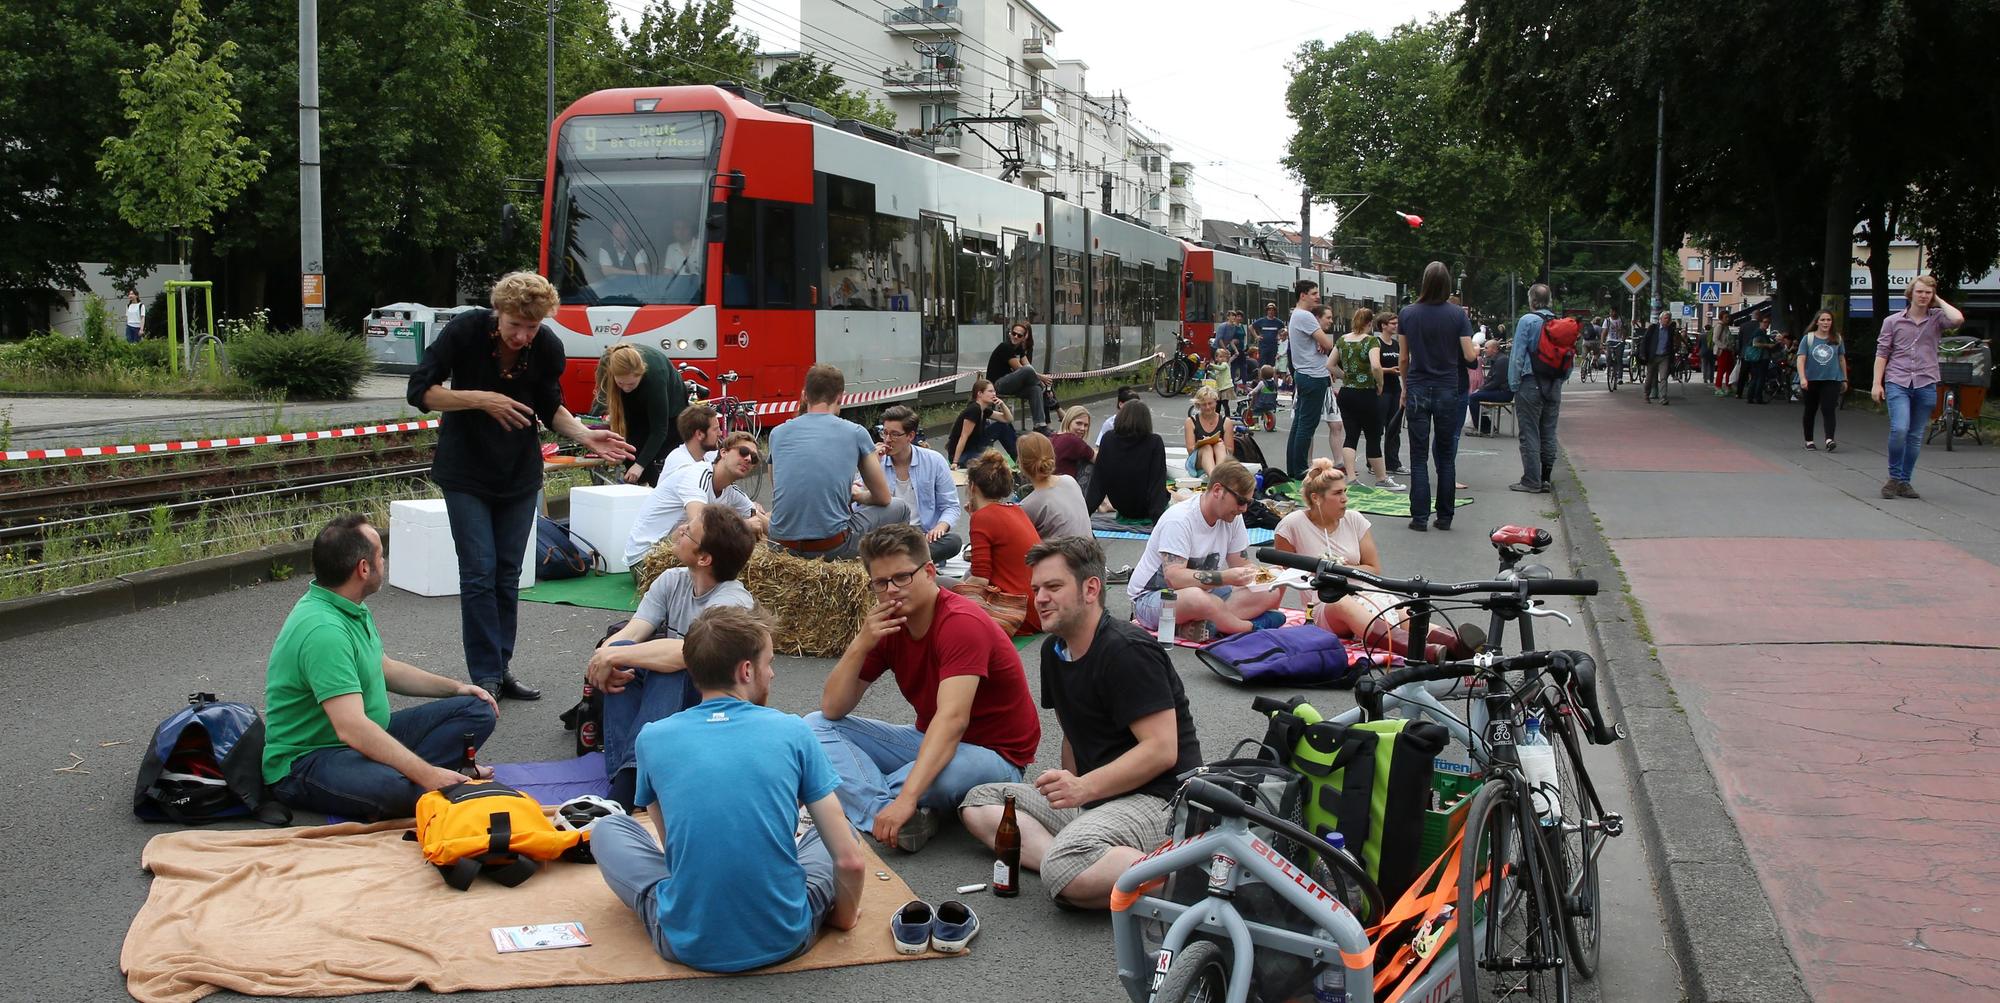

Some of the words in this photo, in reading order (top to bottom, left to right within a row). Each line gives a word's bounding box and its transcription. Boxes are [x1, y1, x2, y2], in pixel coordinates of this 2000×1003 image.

[585, 126, 597, 151] 9
[640, 124, 677, 136] Deutz
[1250, 839, 1345, 912] BULLITT
